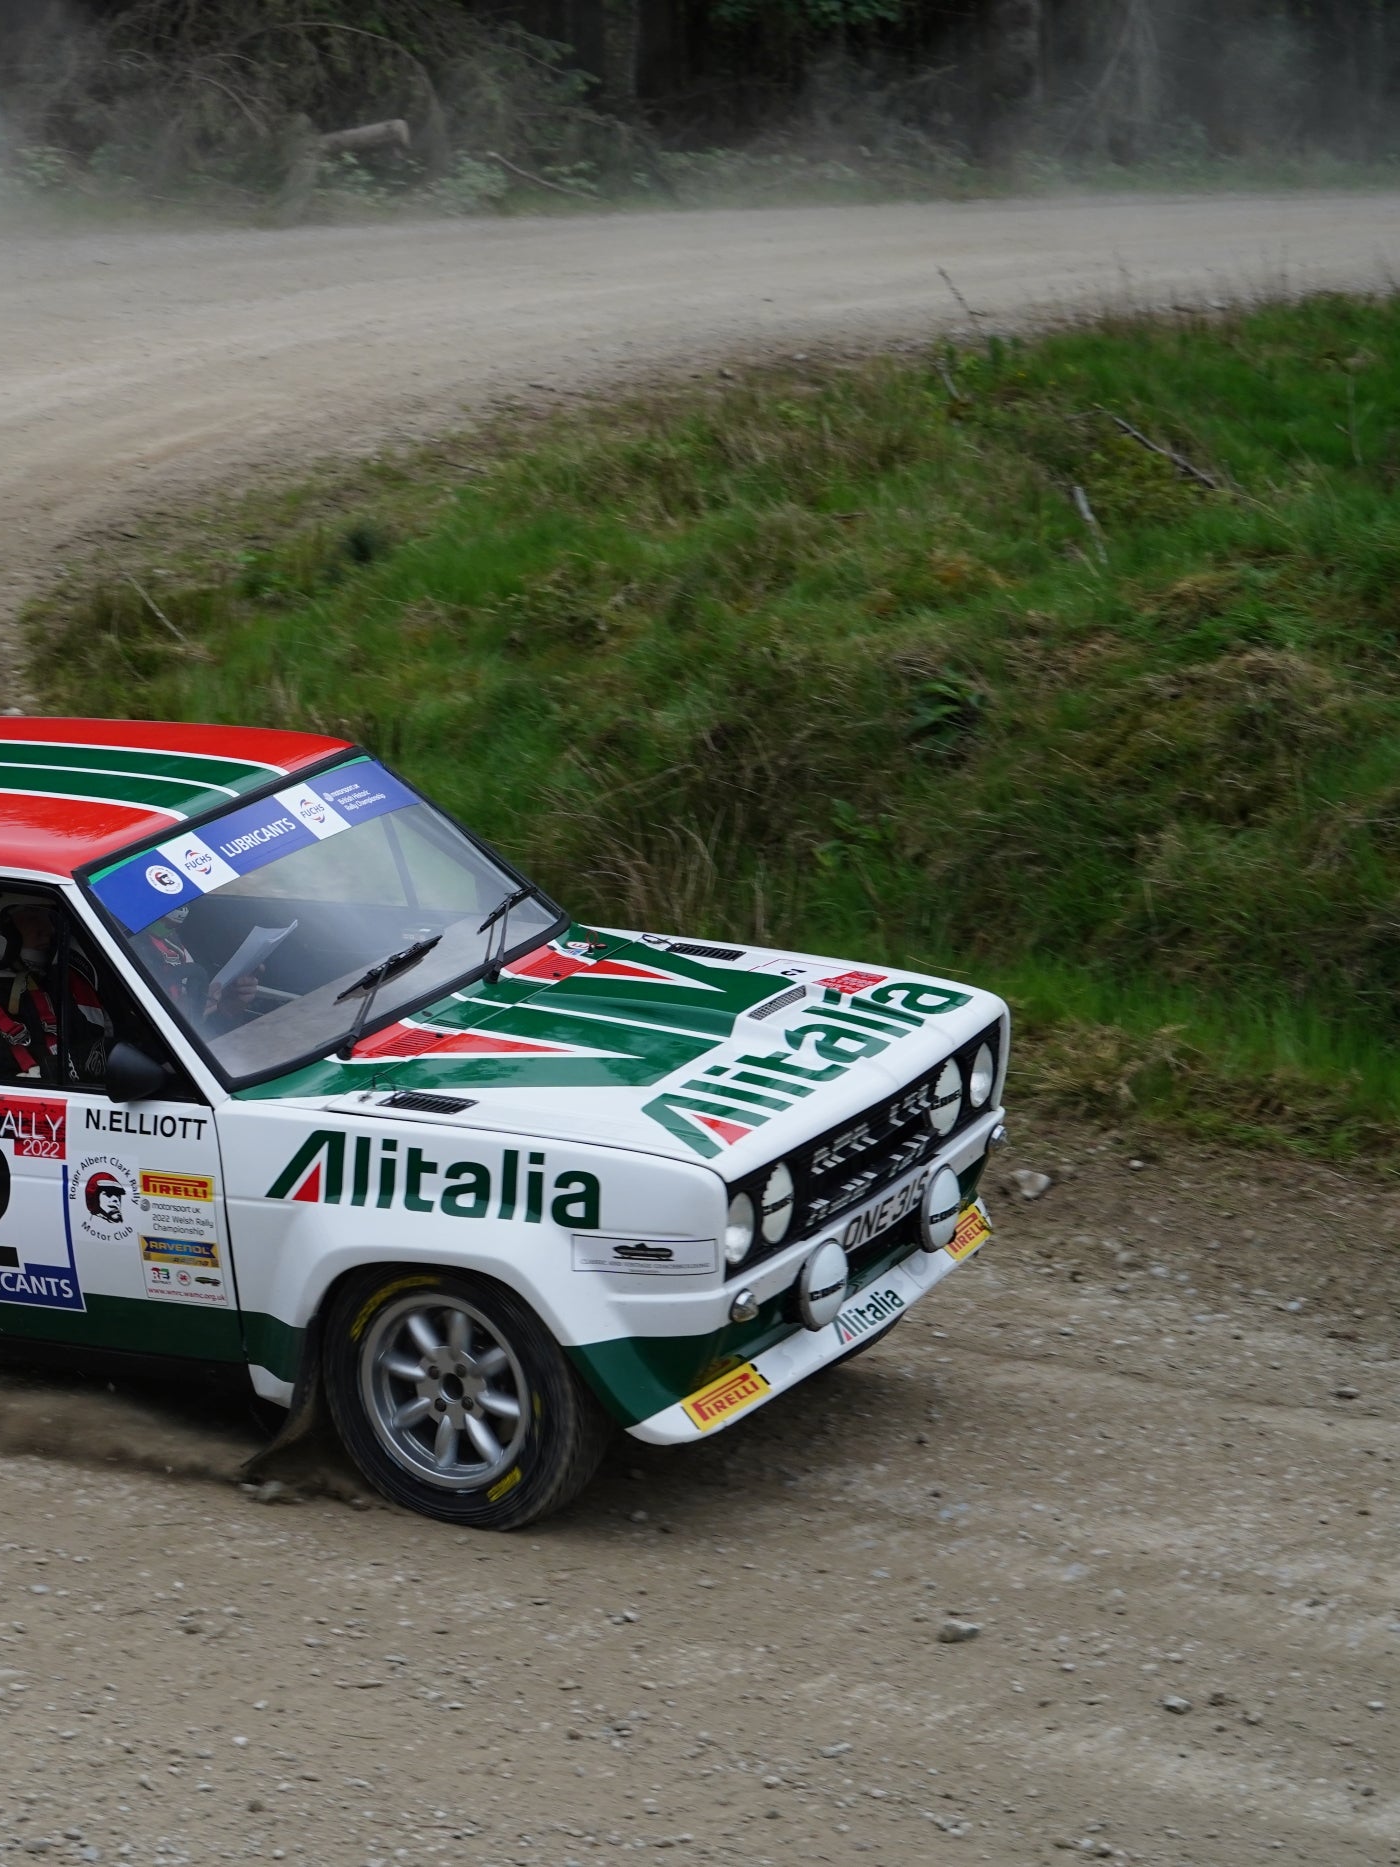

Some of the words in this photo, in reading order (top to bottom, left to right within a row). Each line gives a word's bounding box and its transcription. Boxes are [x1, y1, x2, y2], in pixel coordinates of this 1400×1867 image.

[299, 803, 325, 819] FUCHS
[220, 817, 296, 858] LUBRICANTS
[185, 853, 212, 871] FUCHS
[642, 982, 974, 1159] Alitalia
[85, 1108, 208, 1141] N.ELLIOTT
[22, 1139, 60, 1159] 2022
[69, 1169, 81, 1200] Roger
[80, 1156, 107, 1171] Albert
[109, 1157, 131, 1178] Clark
[129, 1179, 141, 1205] Rally
[142, 1174, 208, 1199] PIRELLI
[265, 1129, 600, 1230] Alitalia
[152, 1202, 191, 1213] motorsport
[152, 1214, 170, 1222] 2022
[172, 1216, 194, 1225] Welsh
[196, 1218, 214, 1229] Rally
[81, 1221, 111, 1242] Motor
[113, 1225, 133, 1241] Club
[153, 1223, 205, 1236] Championship
[844, 1197, 894, 1249] ONE
[831, 1290, 905, 1346] Alitalia
[691, 1372, 760, 1421] PIRELLI
